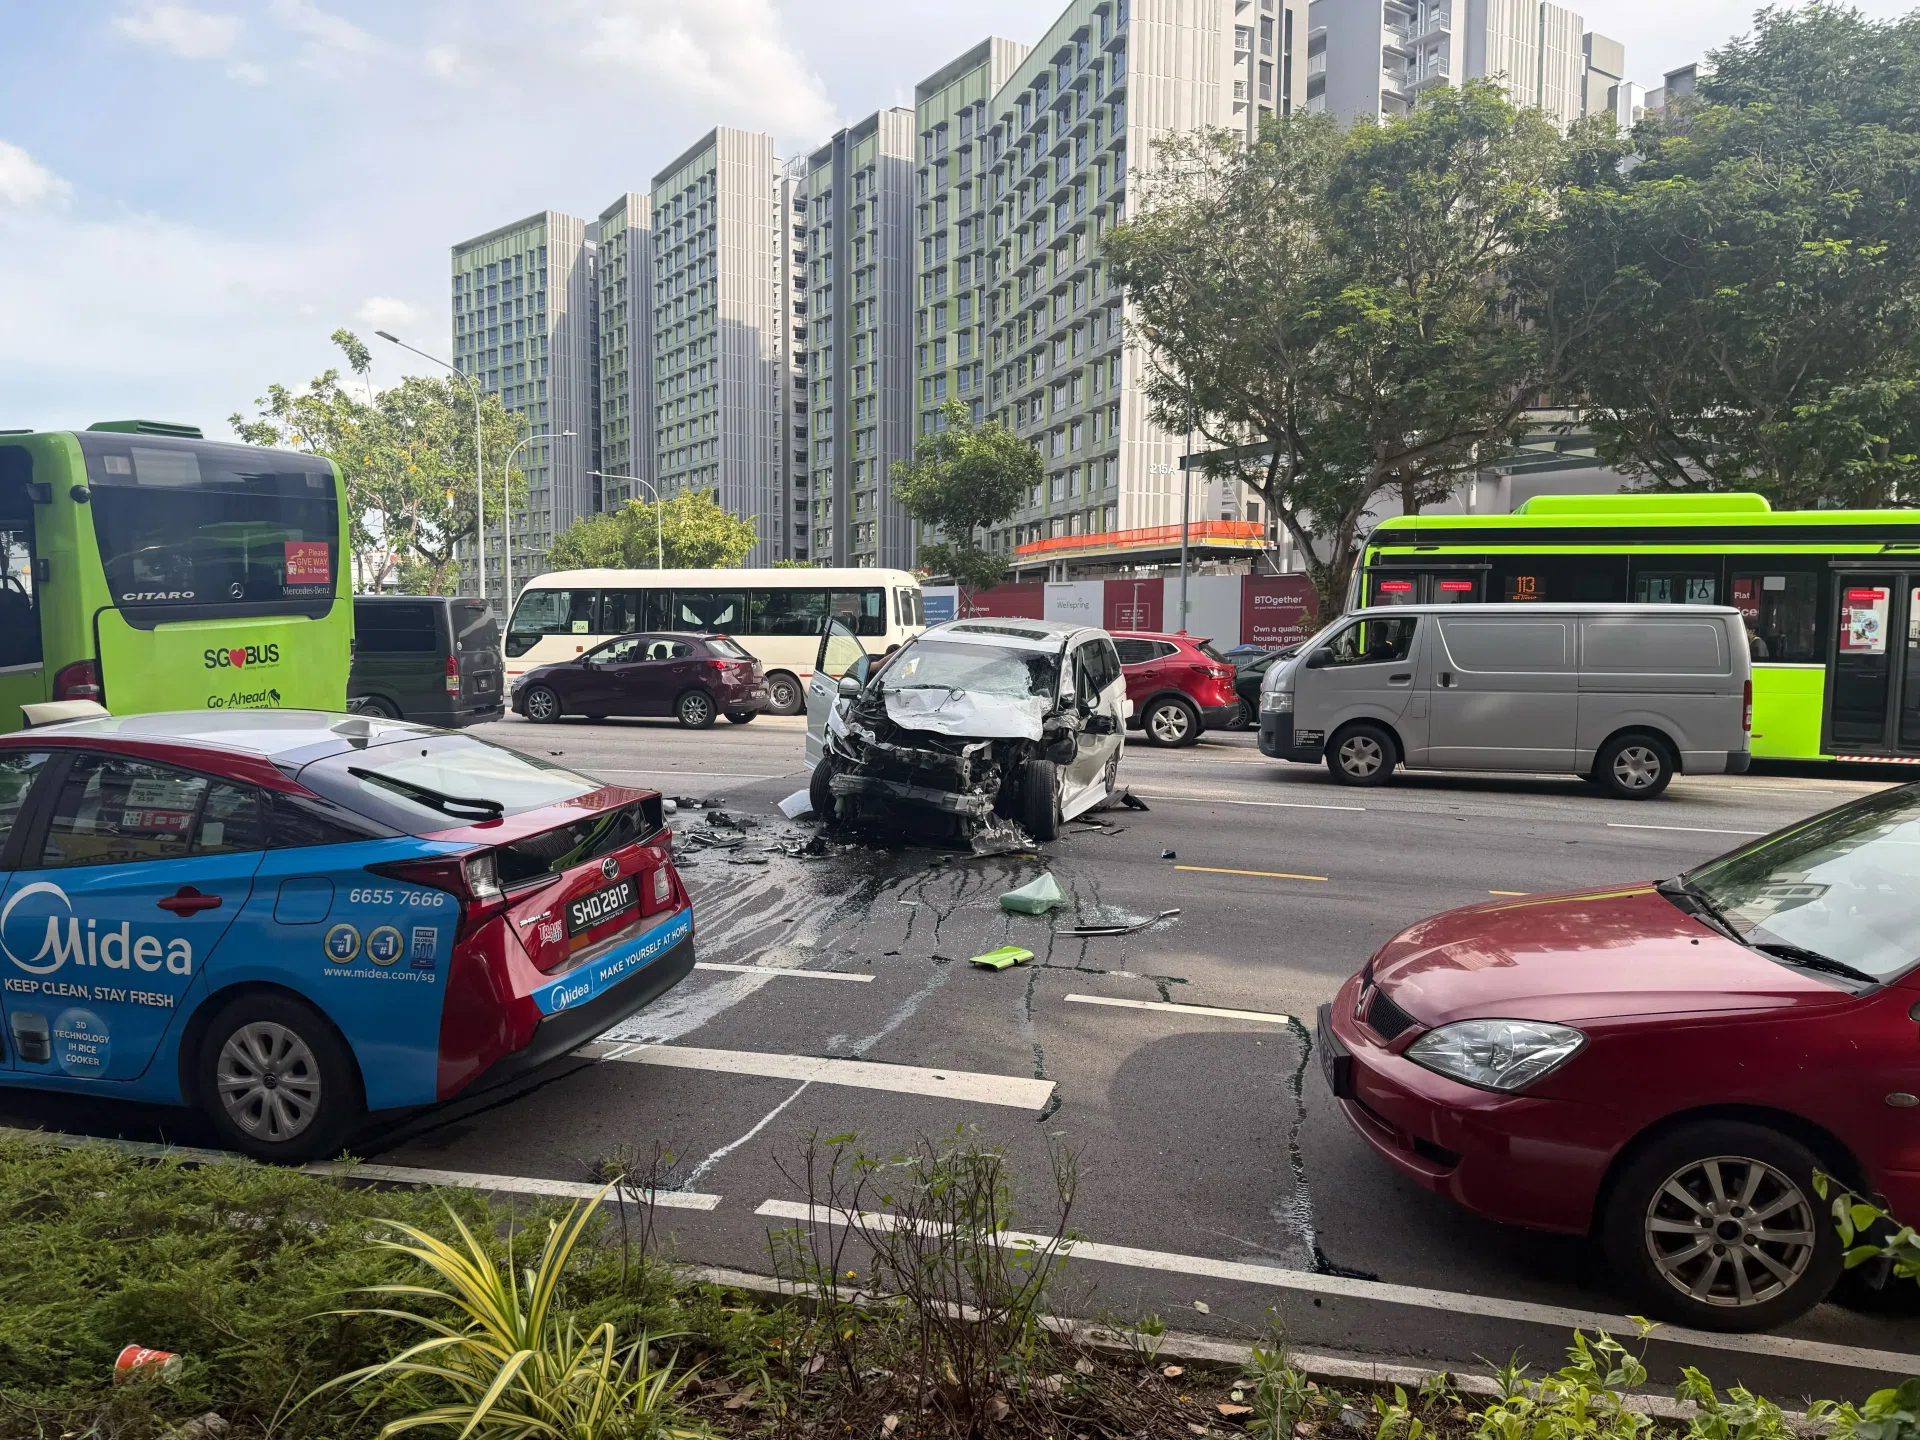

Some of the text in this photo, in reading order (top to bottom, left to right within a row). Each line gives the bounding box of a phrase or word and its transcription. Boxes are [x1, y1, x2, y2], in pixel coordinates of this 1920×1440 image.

[1150, 463, 1176, 475] 215A
[308, 548, 328, 556] Please
[296, 558, 328, 566] GIVE WAY
[314, 566, 328, 574] buses
[1516, 576, 1535, 593] 113
[122, 591, 195, 601] CITARO
[282, 586, 330, 596] Mercedes-Benz
[1734, 592, 1750, 600] Flat
[1254, 596, 1302, 606] BTOgether
[1278, 625, 1303, 634] quality
[1253, 635, 1283, 643] housing
[208, 688, 266, 709] Go-Ahead
[350, 888, 444, 906] 6655 7666
[14, 903, 192, 976] Midea
[600, 922, 688, 982] MAKE YOURSELF AT HOME
[324, 968, 436, 983] www.midea.com/sg
[4, 978, 174, 1008] KEEP CLEAN, STAY FRESH
[556, 983, 590, 1009] Midea
[76, 1021, 86, 1029] 3D
[54, 1030, 110, 1044] TECHNOLOGY
[68, 1042, 96, 1054] IH RICE
[66, 1054, 100, 1066] COOKER
